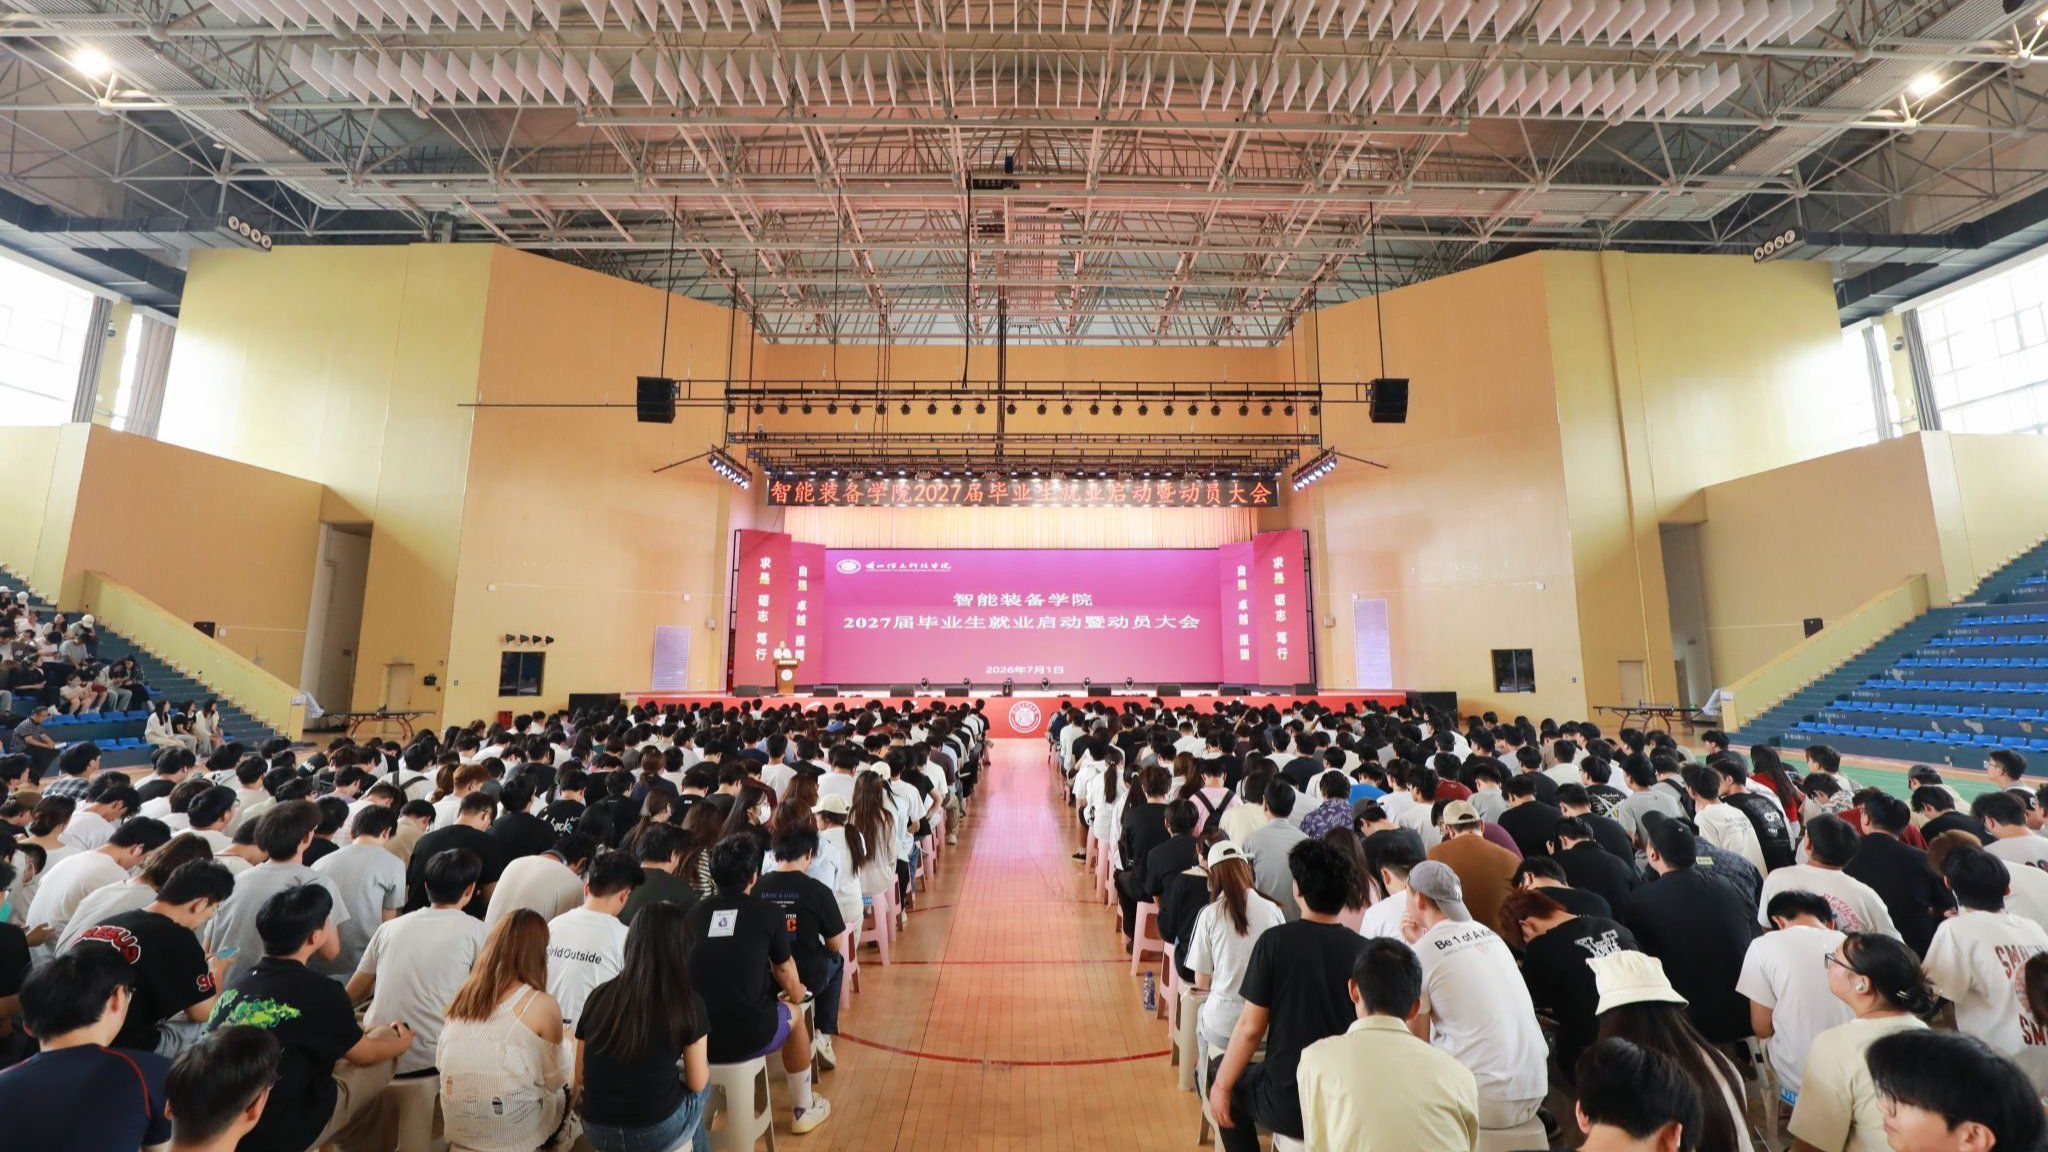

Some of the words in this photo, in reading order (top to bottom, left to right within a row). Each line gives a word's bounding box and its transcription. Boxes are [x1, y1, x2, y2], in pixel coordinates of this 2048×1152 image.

[770, 481, 1272, 505] 智能装备学院2027届毕业生就业启动暨动员大会
[952, 592, 1094, 608] 智能装备学院
[843, 614, 1201, 630] 2027届毕业生就业启动暨动员大会
[985, 665, 1065, 675] 2026年7月1日
[1434, 938, 1453, 950] Be
[1462, 932, 1473, 942] of
